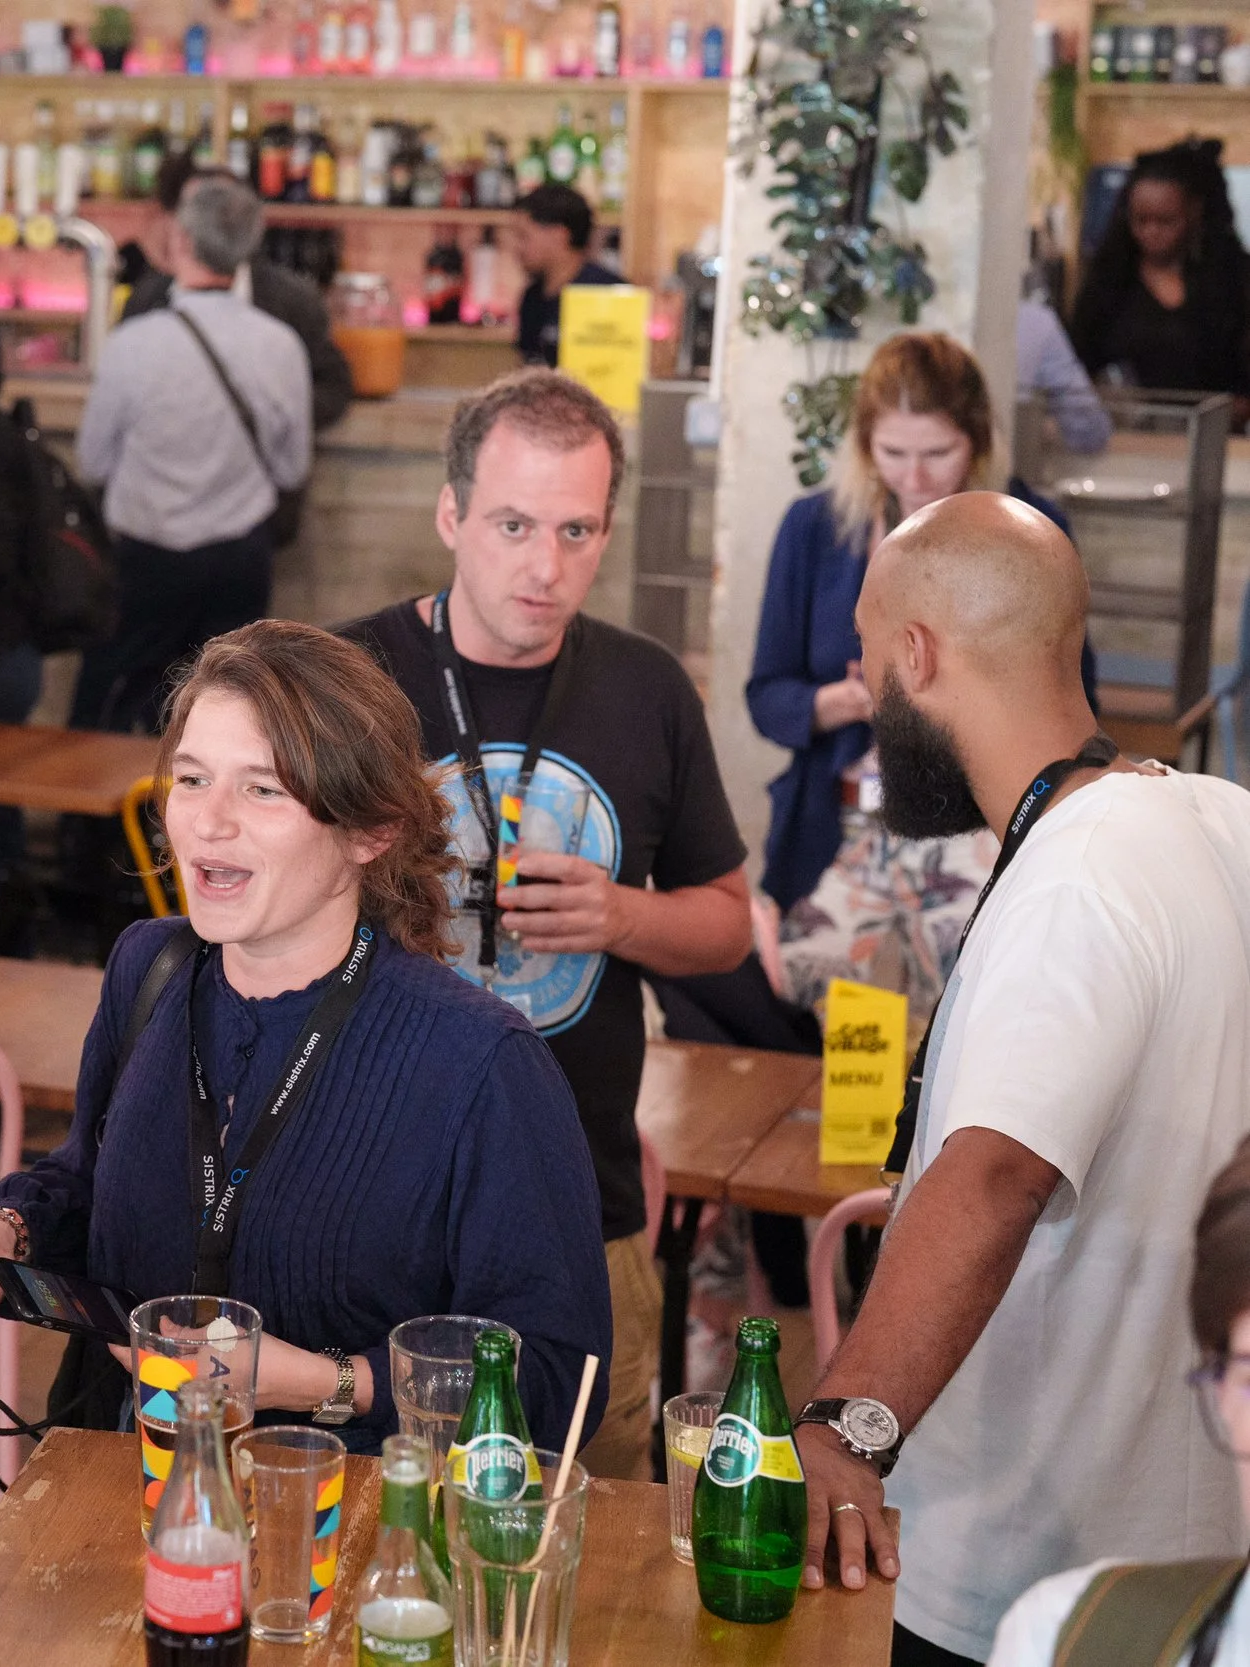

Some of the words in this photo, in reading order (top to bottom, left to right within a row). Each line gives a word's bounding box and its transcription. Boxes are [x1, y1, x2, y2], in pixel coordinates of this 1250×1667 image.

[1011, 793, 1037, 836] SISTRIX
[342, 938, 369, 984] SISTRIX
[270, 1032, 321, 1116] www.sistrix.com
[203, 1155, 216, 1206] SISTRIX
[212, 1184, 236, 1233] SISTRIX
